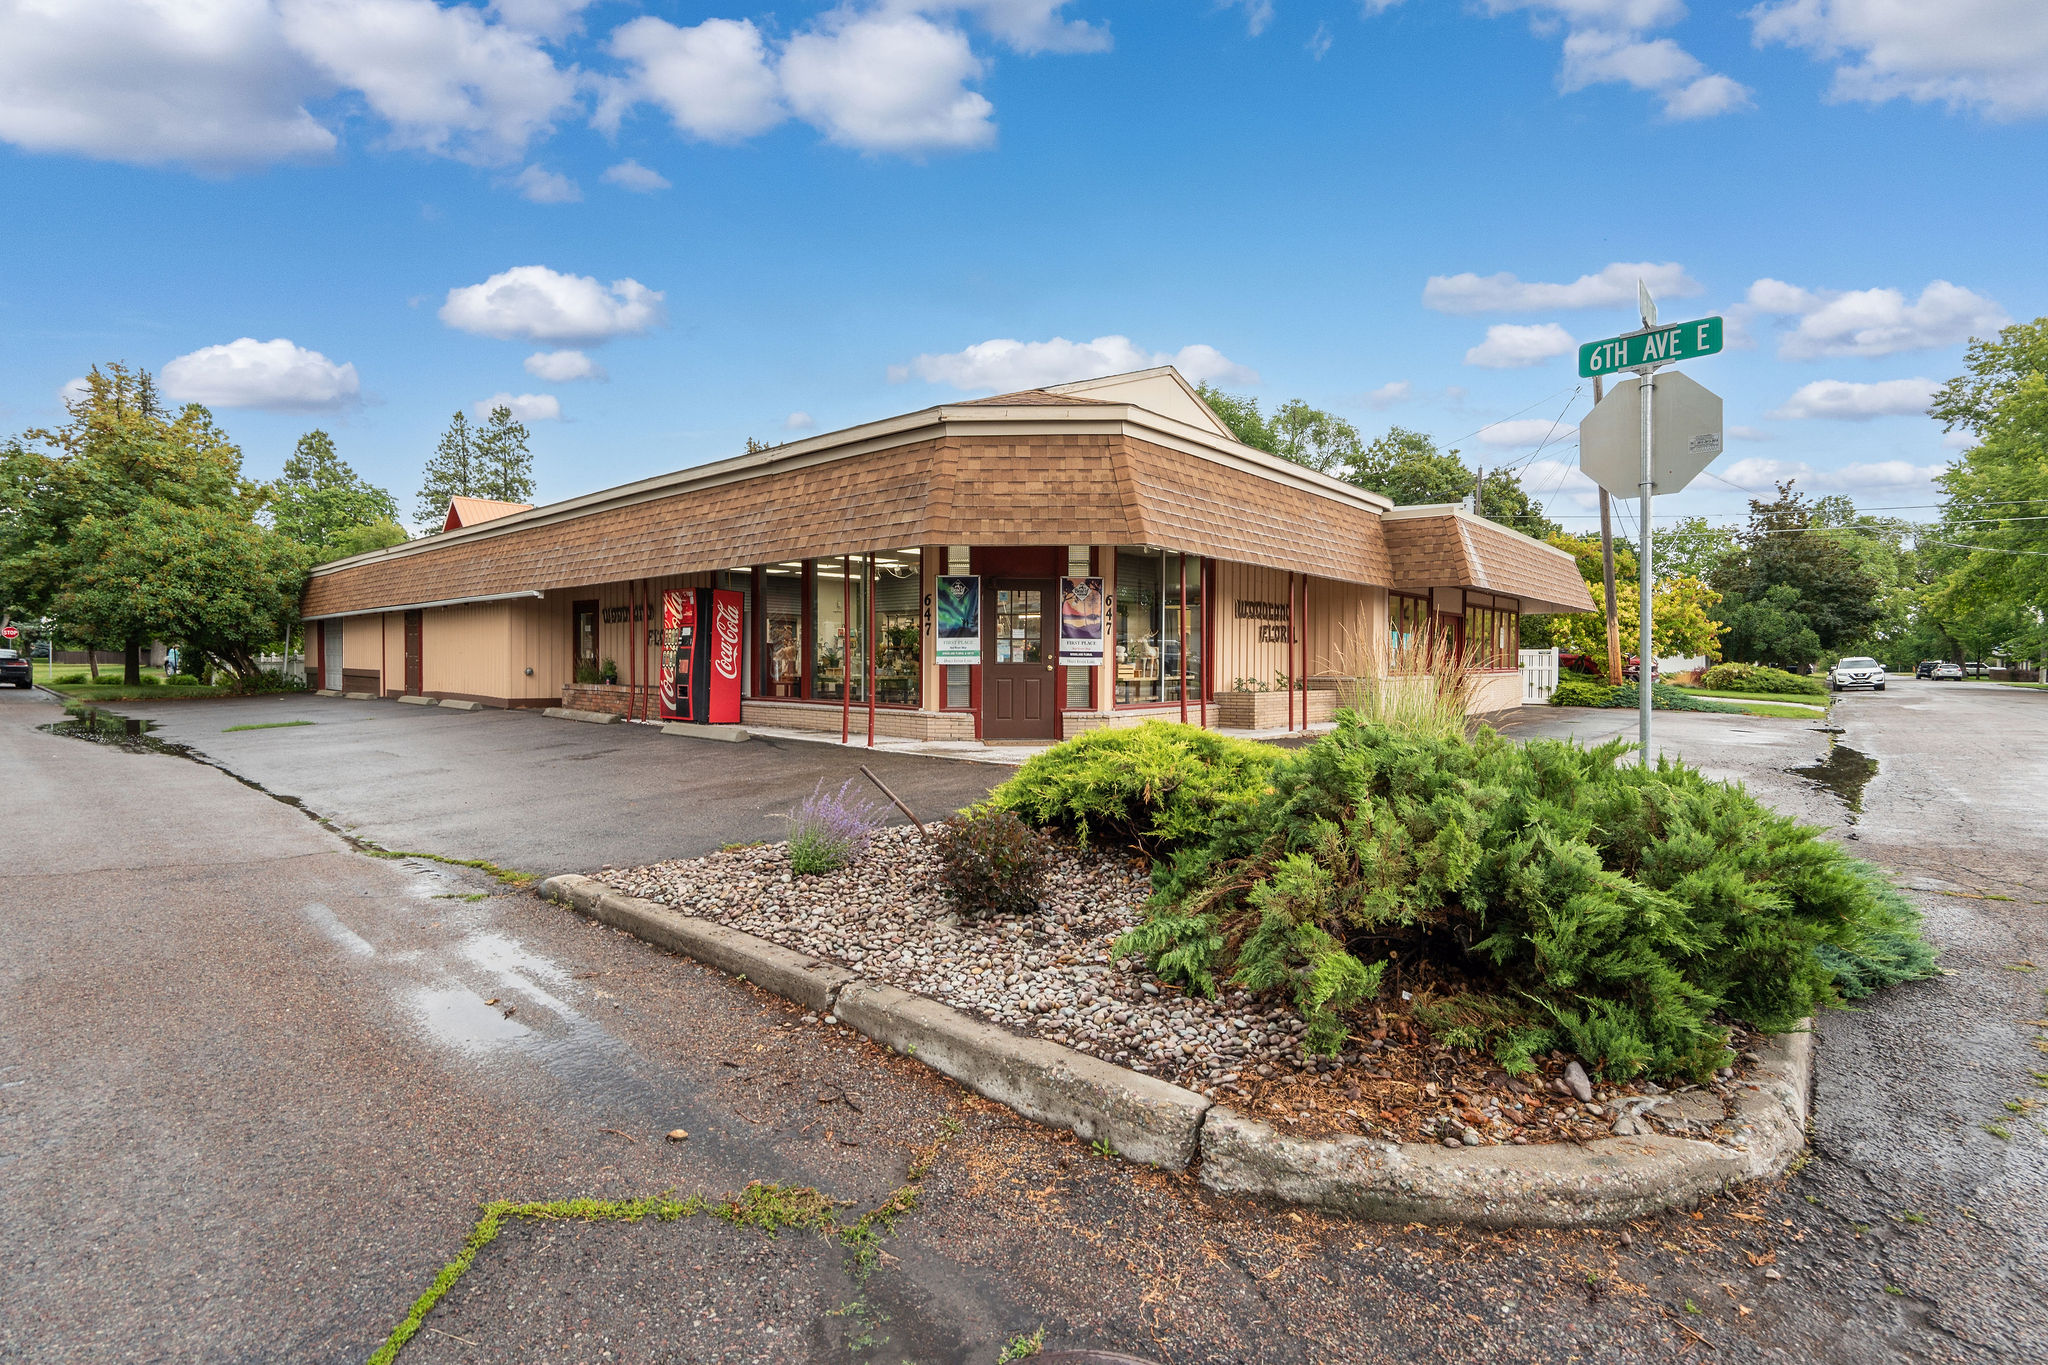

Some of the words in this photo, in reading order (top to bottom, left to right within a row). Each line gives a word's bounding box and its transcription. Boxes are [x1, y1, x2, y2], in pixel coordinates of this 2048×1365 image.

[1589, 340, 1628, 371] 6TH
[1642, 329, 1682, 362] AVE
[1697, 323, 1710, 351] E
[924, 593, 932, 636] 647
[1105, 594, 1113, 636] 647
